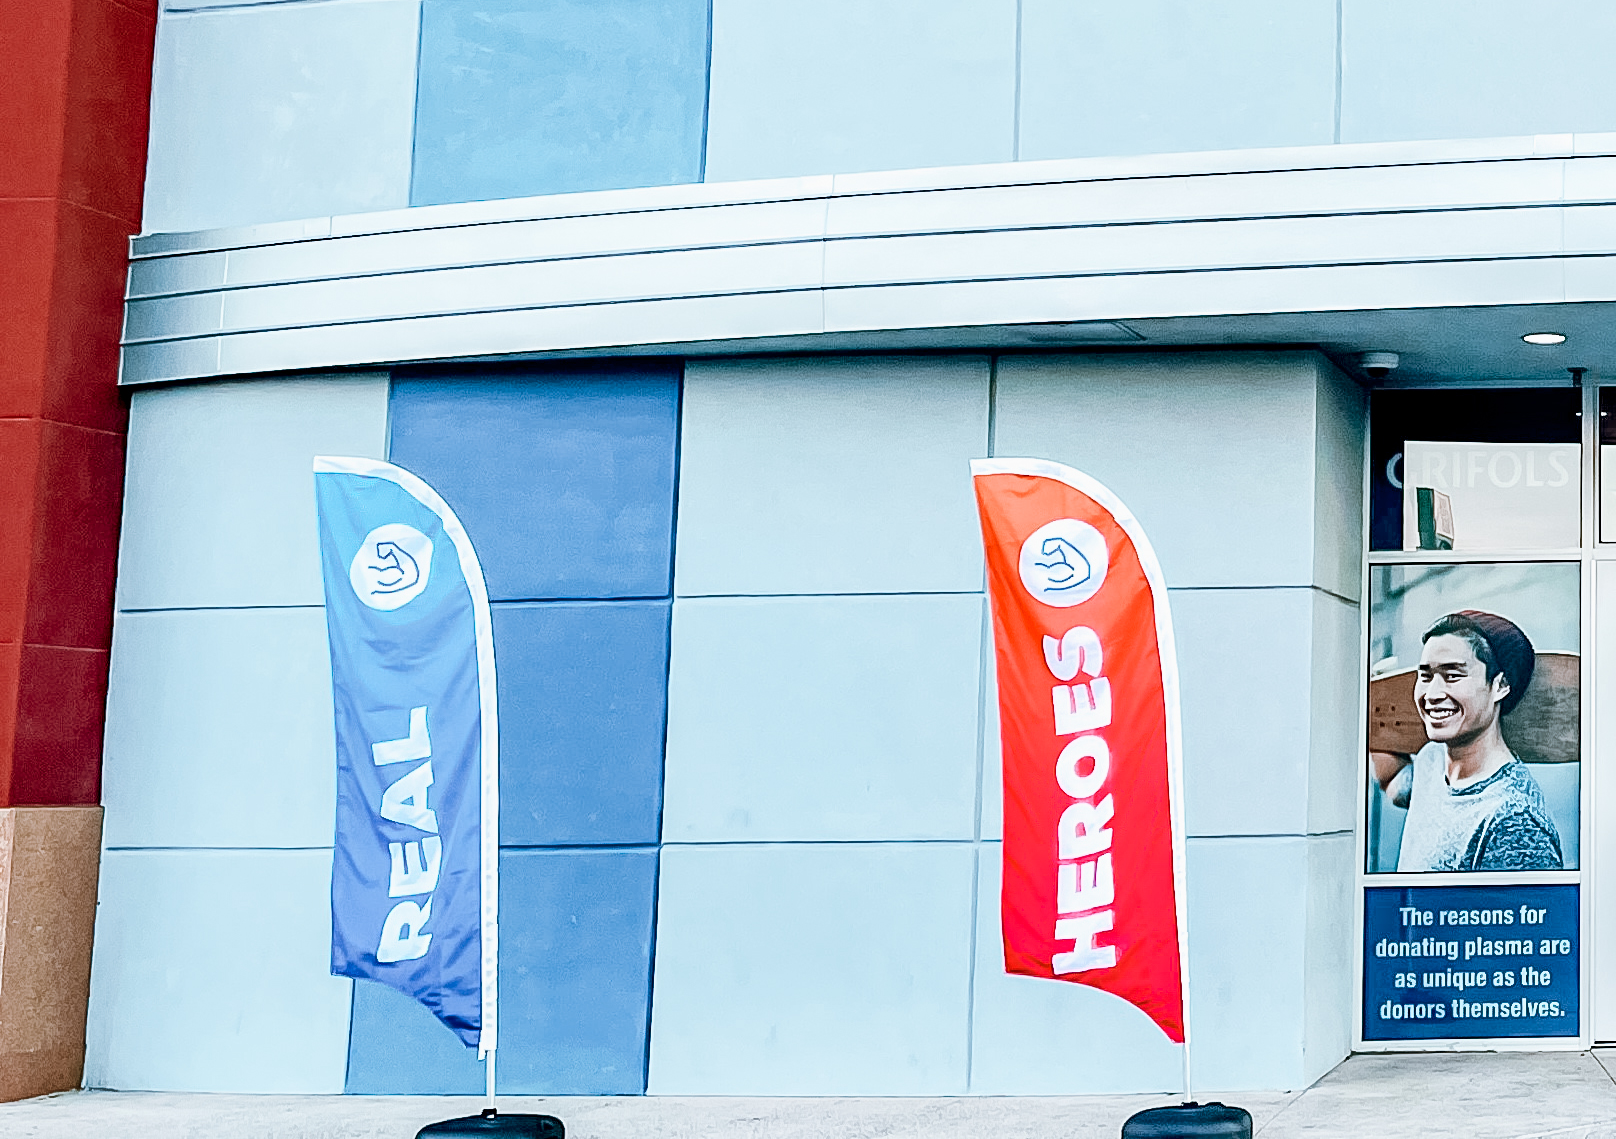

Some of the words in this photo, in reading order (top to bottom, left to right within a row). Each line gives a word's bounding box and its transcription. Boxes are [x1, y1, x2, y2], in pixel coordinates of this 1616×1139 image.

[1386, 450, 1569, 488] GRIFOLS
[1042, 625, 1118, 976] HEROES
[371, 705, 443, 963] REAL
[1400, 907, 1433, 926] The
[1439, 909, 1514, 926] reasons
[1519, 905, 1547, 924] for
[1375, 938, 1459, 961] donating
[1465, 937, 1533, 960] plasma
[1539, 939, 1571, 955] are
[1394, 972, 1417, 988] as
[1423, 968, 1487, 991] unique
[1493, 971, 1515, 987] as
[1520, 966, 1551, 986] the
[1379, 1000, 1446, 1020] donors
[1451, 998, 1565, 1018] themselves.
